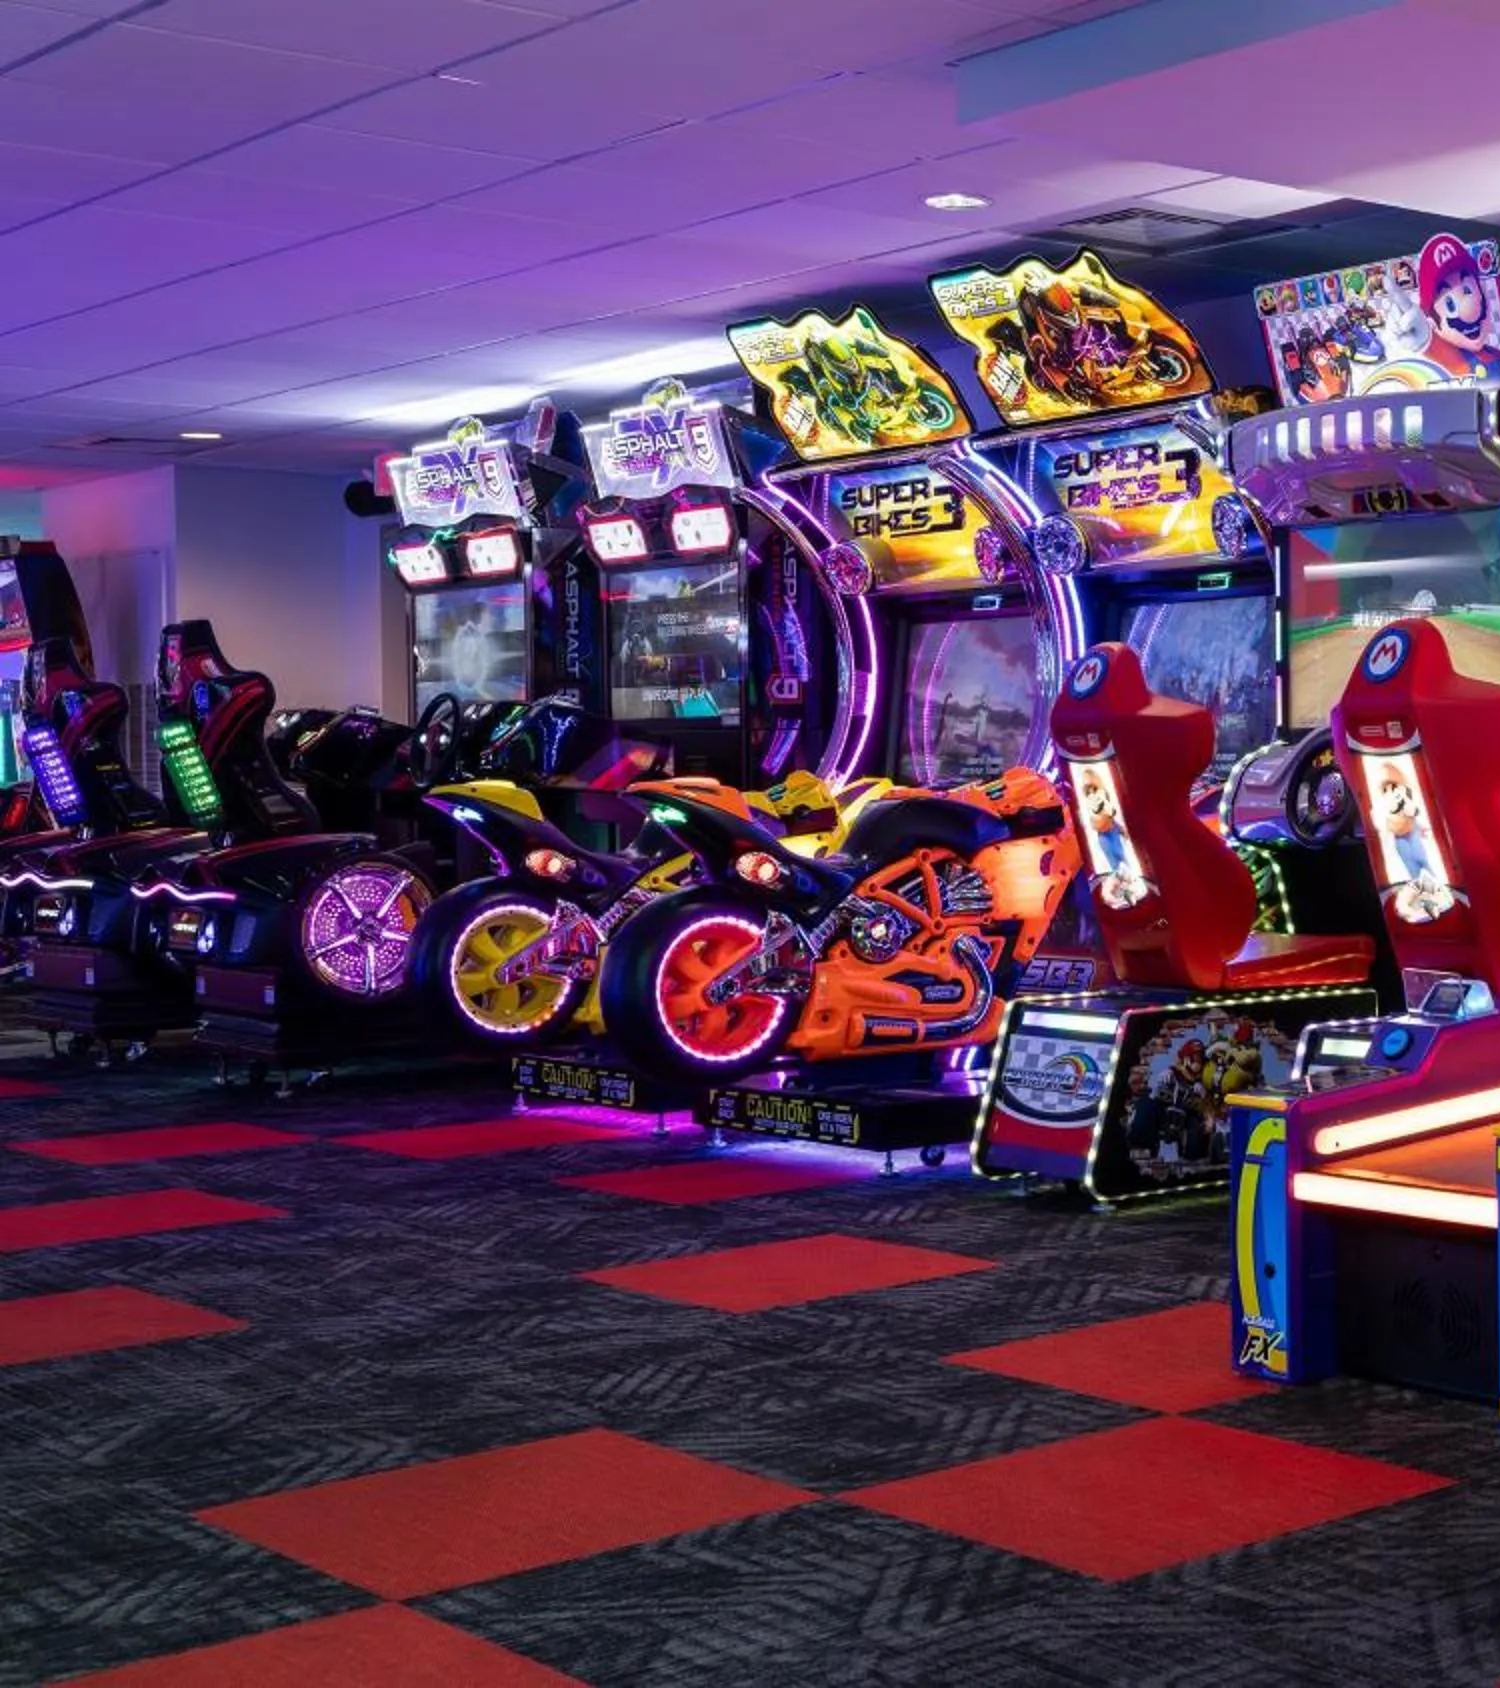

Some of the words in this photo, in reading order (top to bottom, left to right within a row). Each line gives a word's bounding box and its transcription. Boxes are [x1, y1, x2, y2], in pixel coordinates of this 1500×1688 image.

[1054, 441, 1162, 479] SUPER
[841, 477, 931, 510] SUPER
[854, 506, 932, 537] BIKES
[564, 560, 581, 679] ASPHALT
[1240, 1331, 1285, 1365] FX
